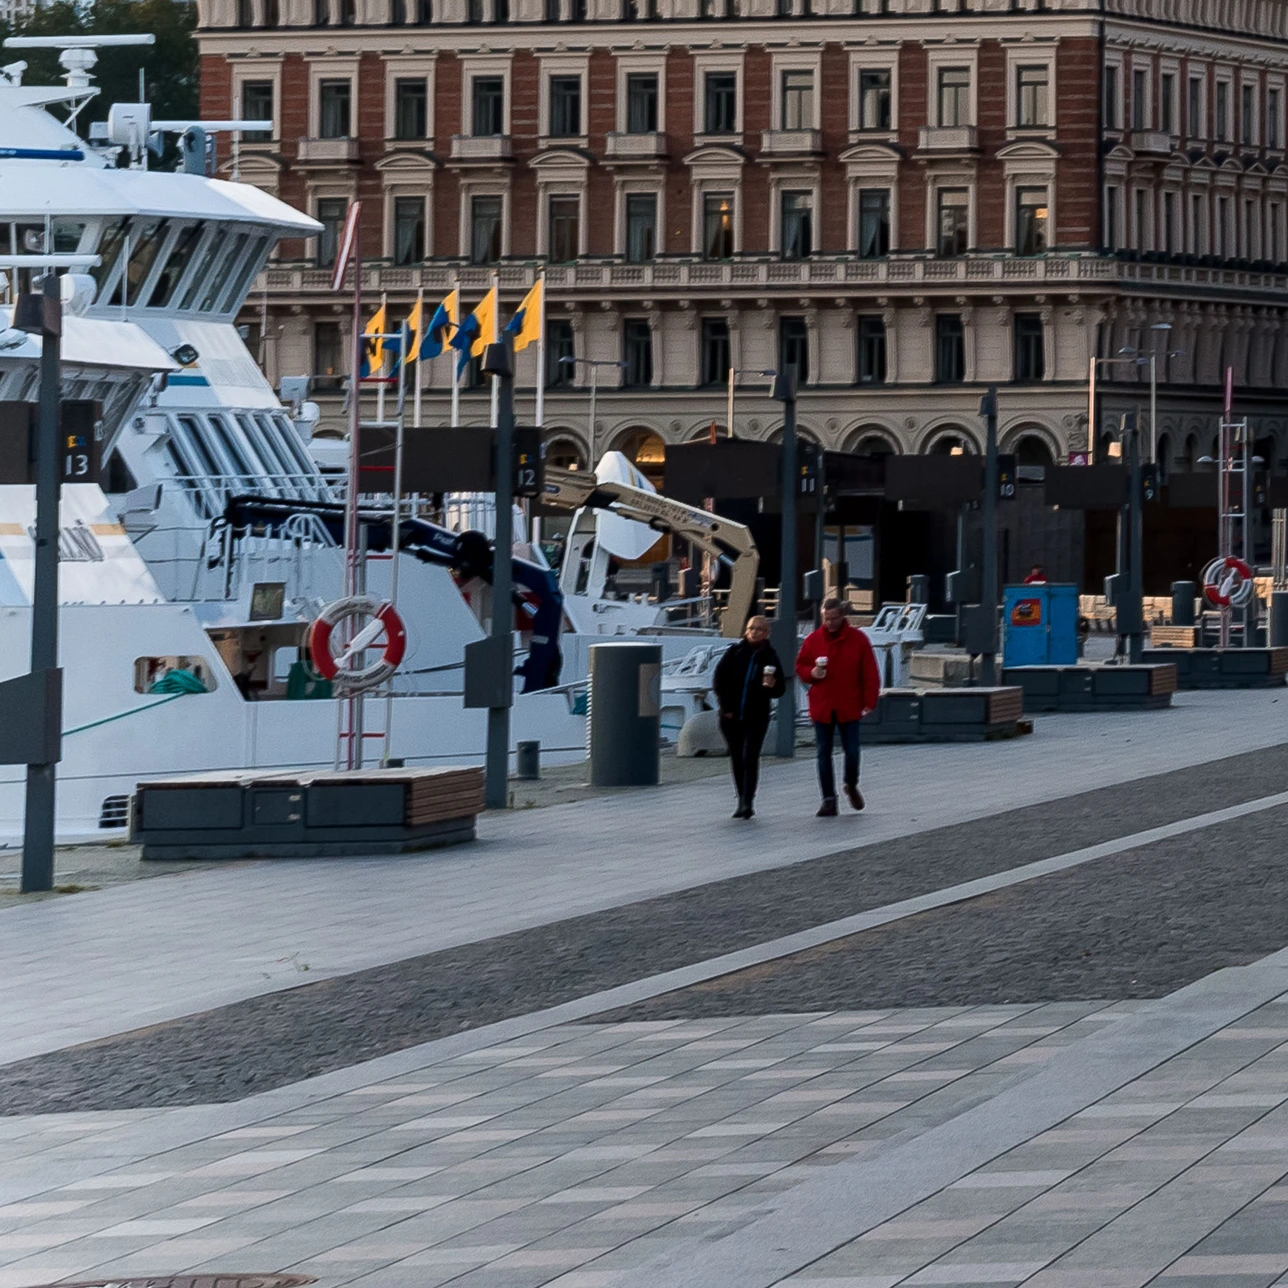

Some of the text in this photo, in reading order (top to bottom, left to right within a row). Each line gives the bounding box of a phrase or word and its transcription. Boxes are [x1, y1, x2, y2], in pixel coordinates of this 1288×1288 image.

[65, 454, 89, 476] 13
[518, 469, 536, 488] 12
[801, 478, 815, 493] 11
[1000, 483, 1014, 497] 10
[1145, 489, 1154, 500] 9
